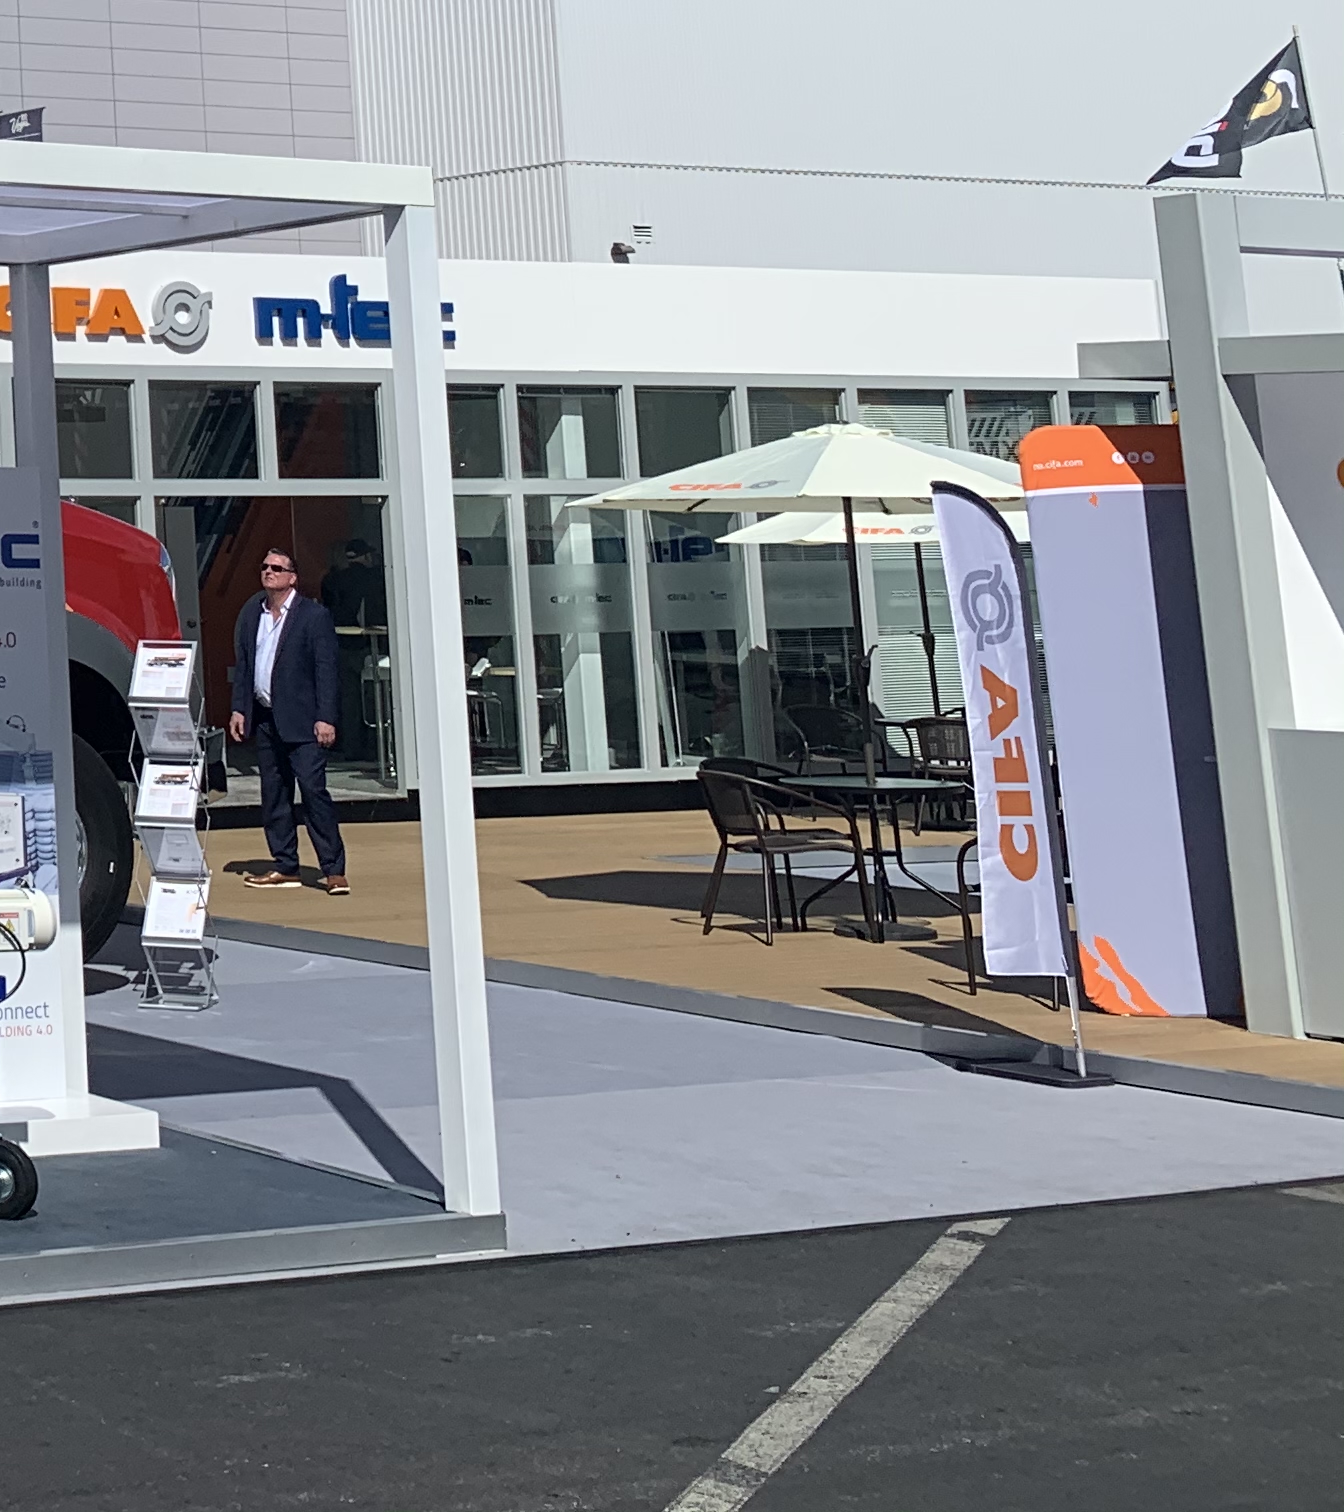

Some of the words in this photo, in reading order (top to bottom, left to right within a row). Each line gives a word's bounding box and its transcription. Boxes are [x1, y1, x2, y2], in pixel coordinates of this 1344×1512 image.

[252, 273, 456, 343] m-te
[0, 577, 42, 589] building
[36, 1024, 53, 1036] 4.0
